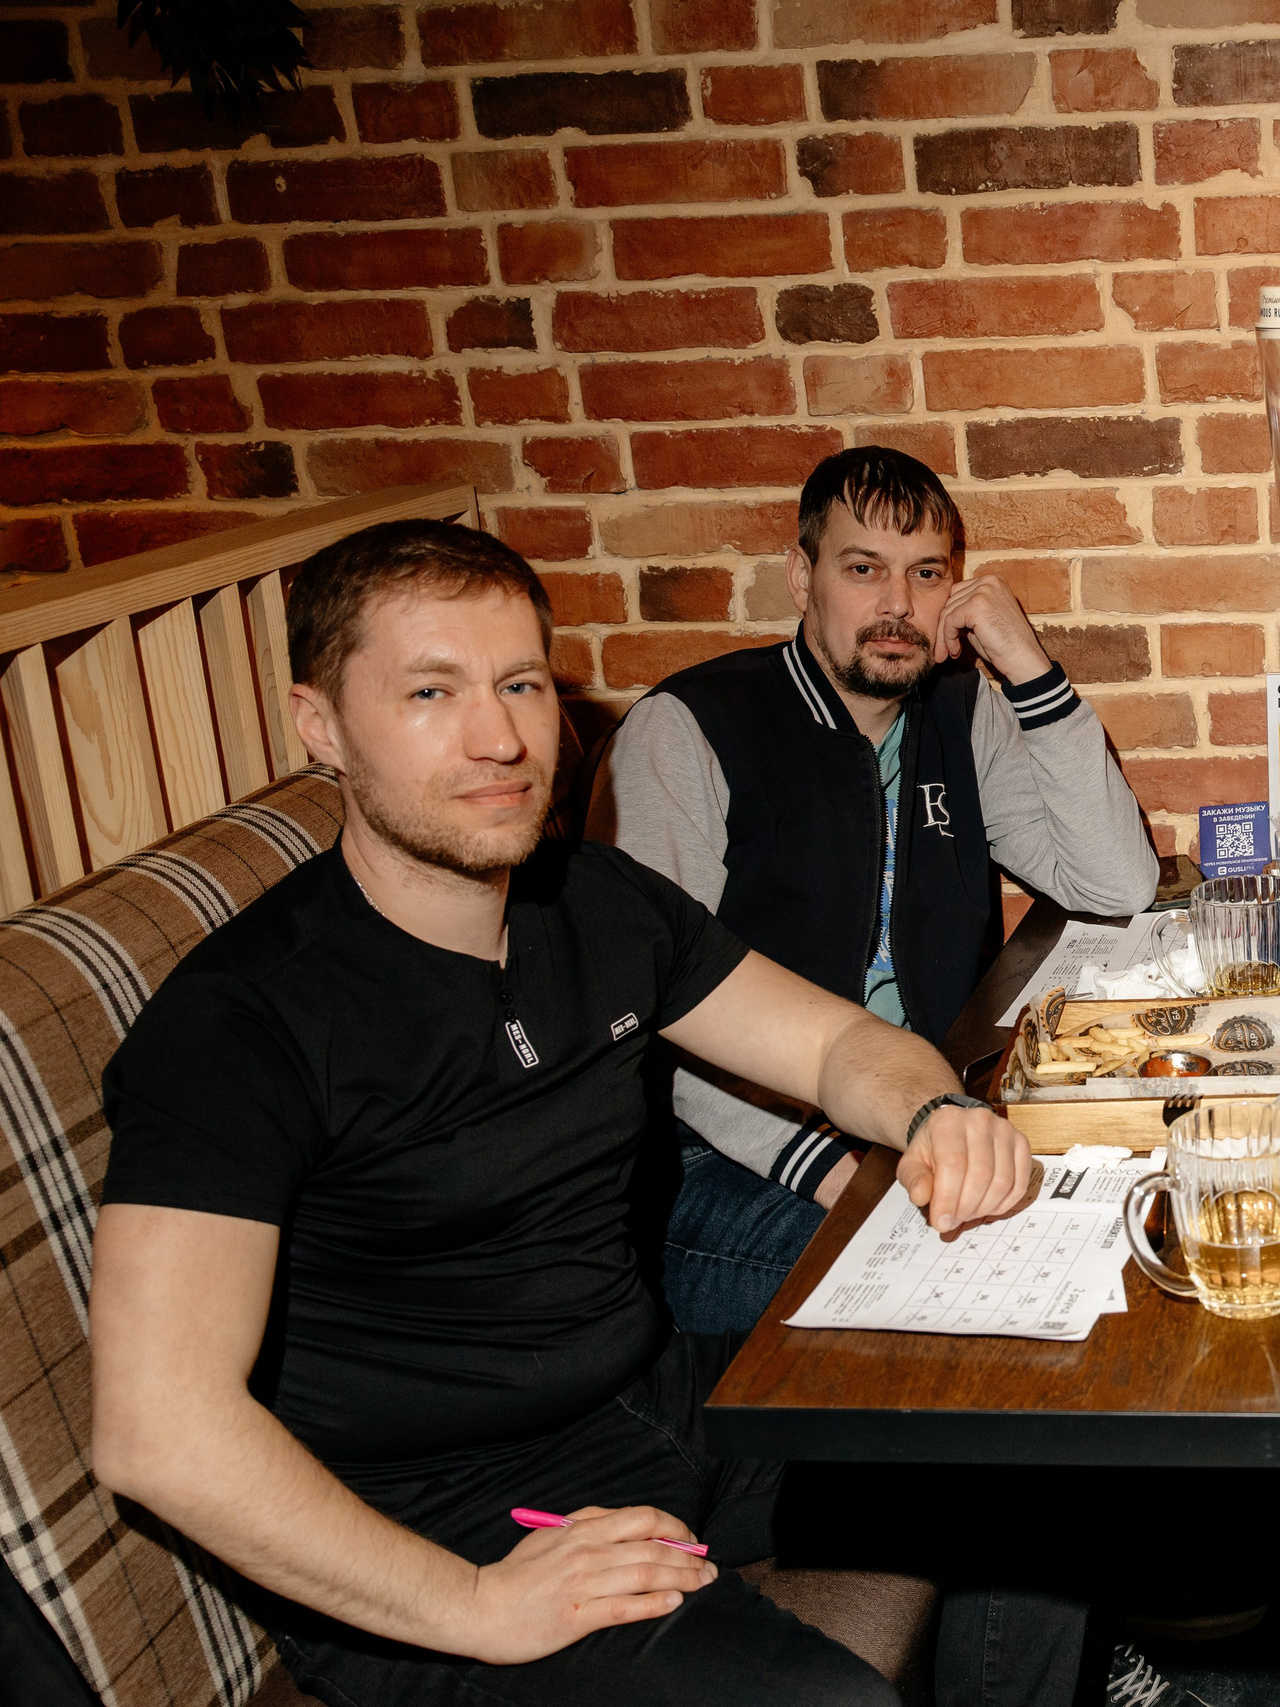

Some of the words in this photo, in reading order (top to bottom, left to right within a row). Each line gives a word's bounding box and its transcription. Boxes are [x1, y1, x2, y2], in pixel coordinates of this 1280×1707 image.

[1202, 808, 1233, 816] ЗАКАЖИ
[1235, 805, 1266, 813] МУЗЫКУ
[1219, 814, 1255, 822] ЗАВЕДЕНИИ
[1092, 1168, 1142, 1176] ЗАКУСК
